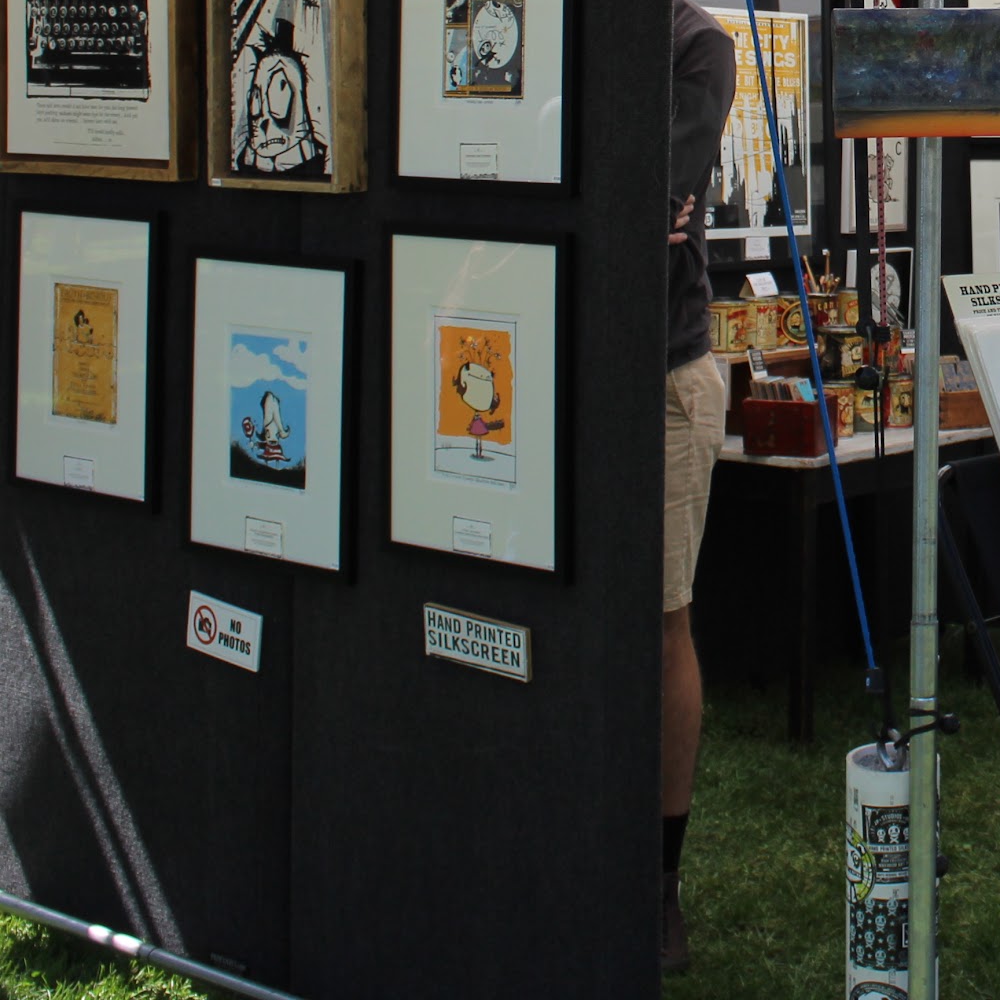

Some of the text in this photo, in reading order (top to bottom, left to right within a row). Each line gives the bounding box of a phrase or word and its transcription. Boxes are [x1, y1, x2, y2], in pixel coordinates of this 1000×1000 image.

[745, 50, 796, 67] SNGS
[959, 284, 991, 296] HAND
[230, 618, 242, 634] NO
[427, 610, 521, 649] HAND PRINTED
[218, 631, 251, 655] PHOTOS
[428, 629, 520, 668] SILKSCREEN
